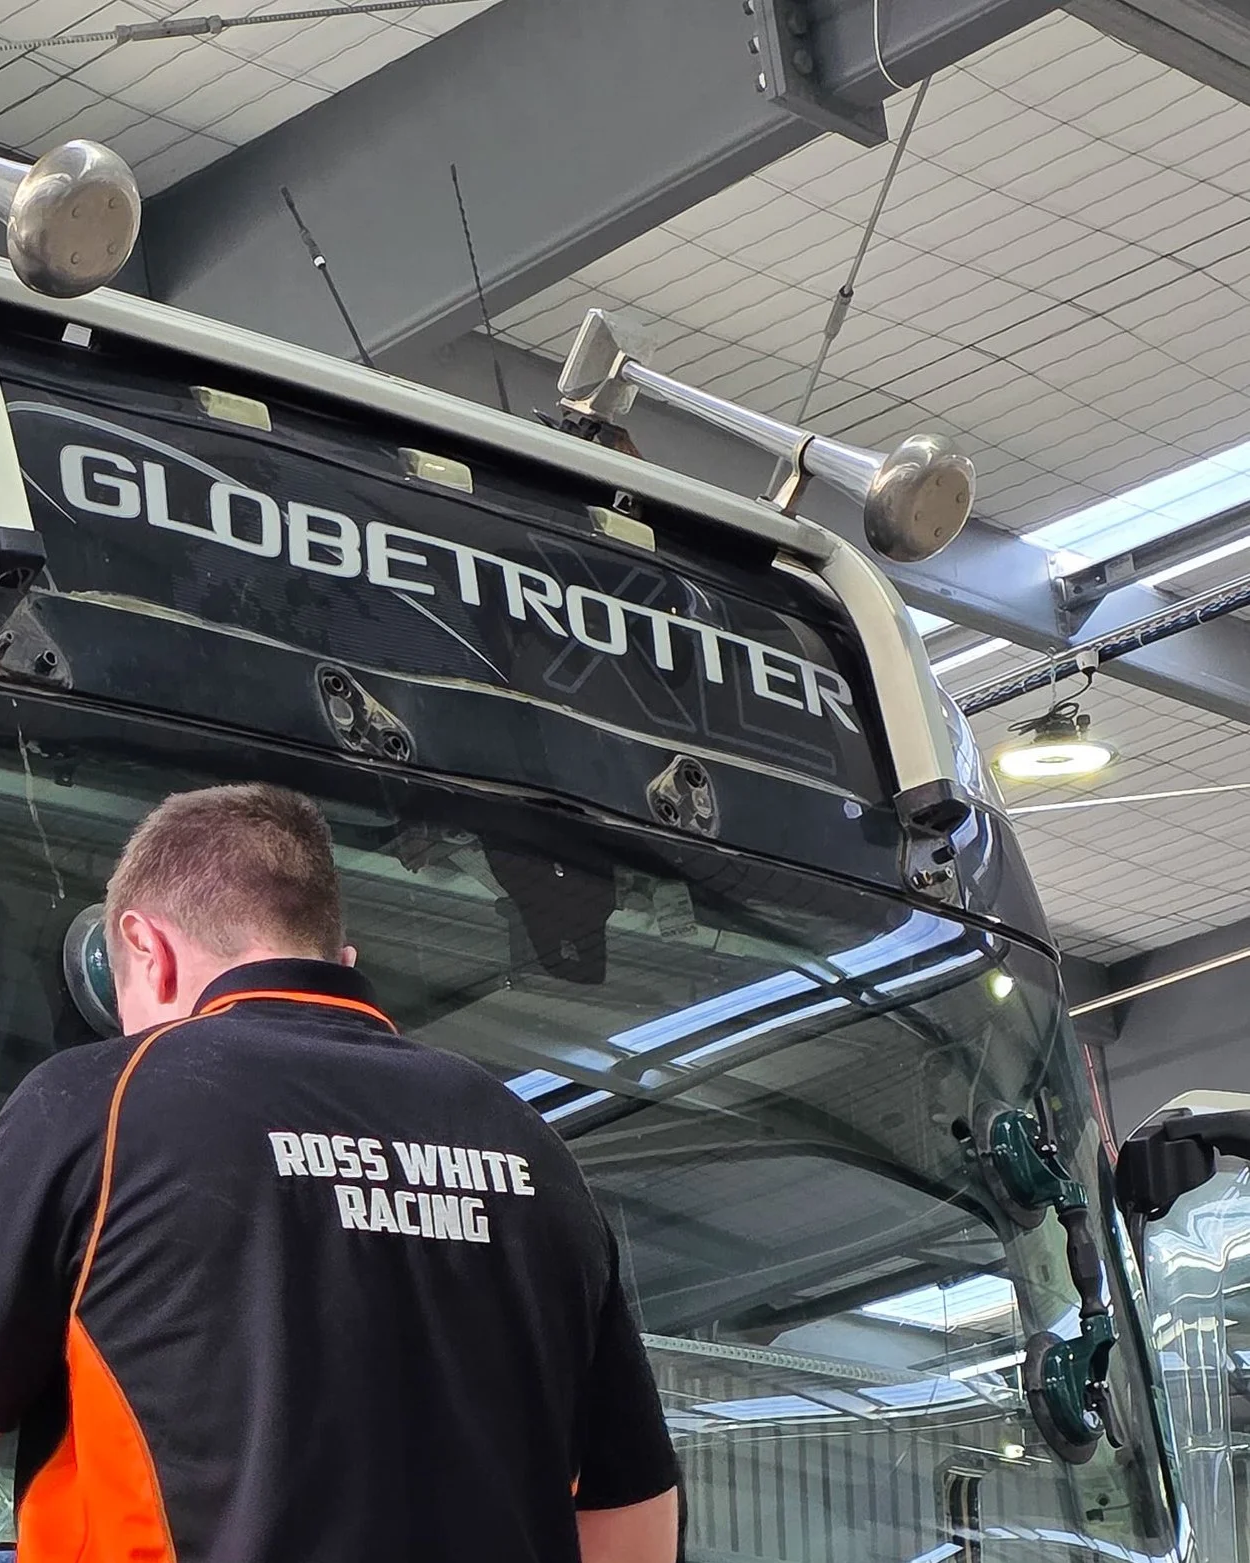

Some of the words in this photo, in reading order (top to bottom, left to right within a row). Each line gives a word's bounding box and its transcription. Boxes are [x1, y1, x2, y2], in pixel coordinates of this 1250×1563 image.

[59, 444, 861, 734] GLOBETROTTER
[268, 1132, 389, 1181] ROSS
[392, 1141, 535, 1196] WHITE
[333, 1184, 490, 1243] RACING
